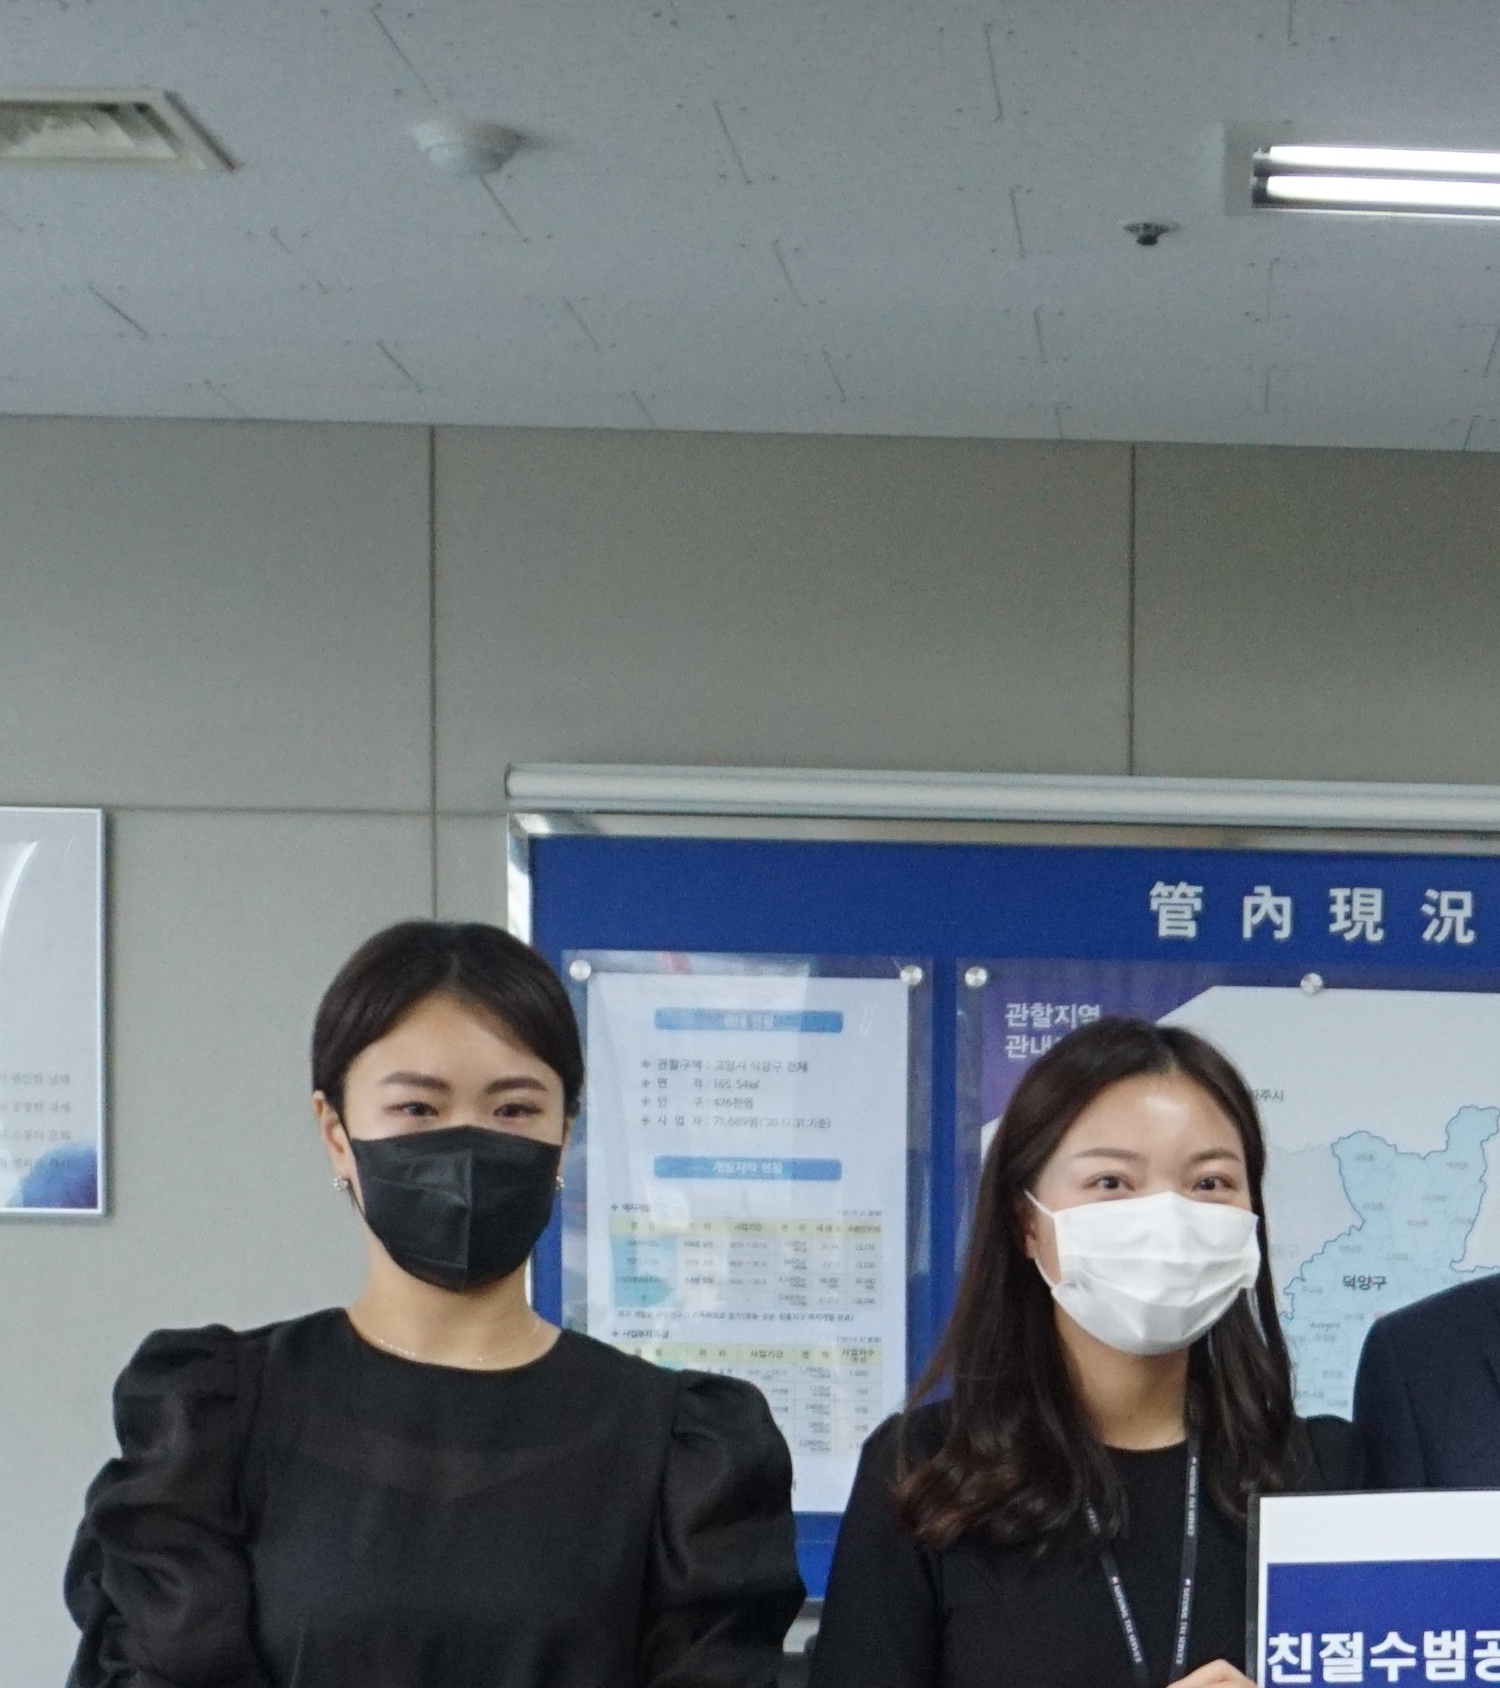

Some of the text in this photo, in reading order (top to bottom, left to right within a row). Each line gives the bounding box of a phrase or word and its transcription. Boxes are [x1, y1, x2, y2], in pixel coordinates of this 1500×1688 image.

[1149, 881, 1476, 944] 管內現況
[1005, 1002, 1101, 1029] 관할지역
[1342, 1274, 1388, 1291] 덕양구
